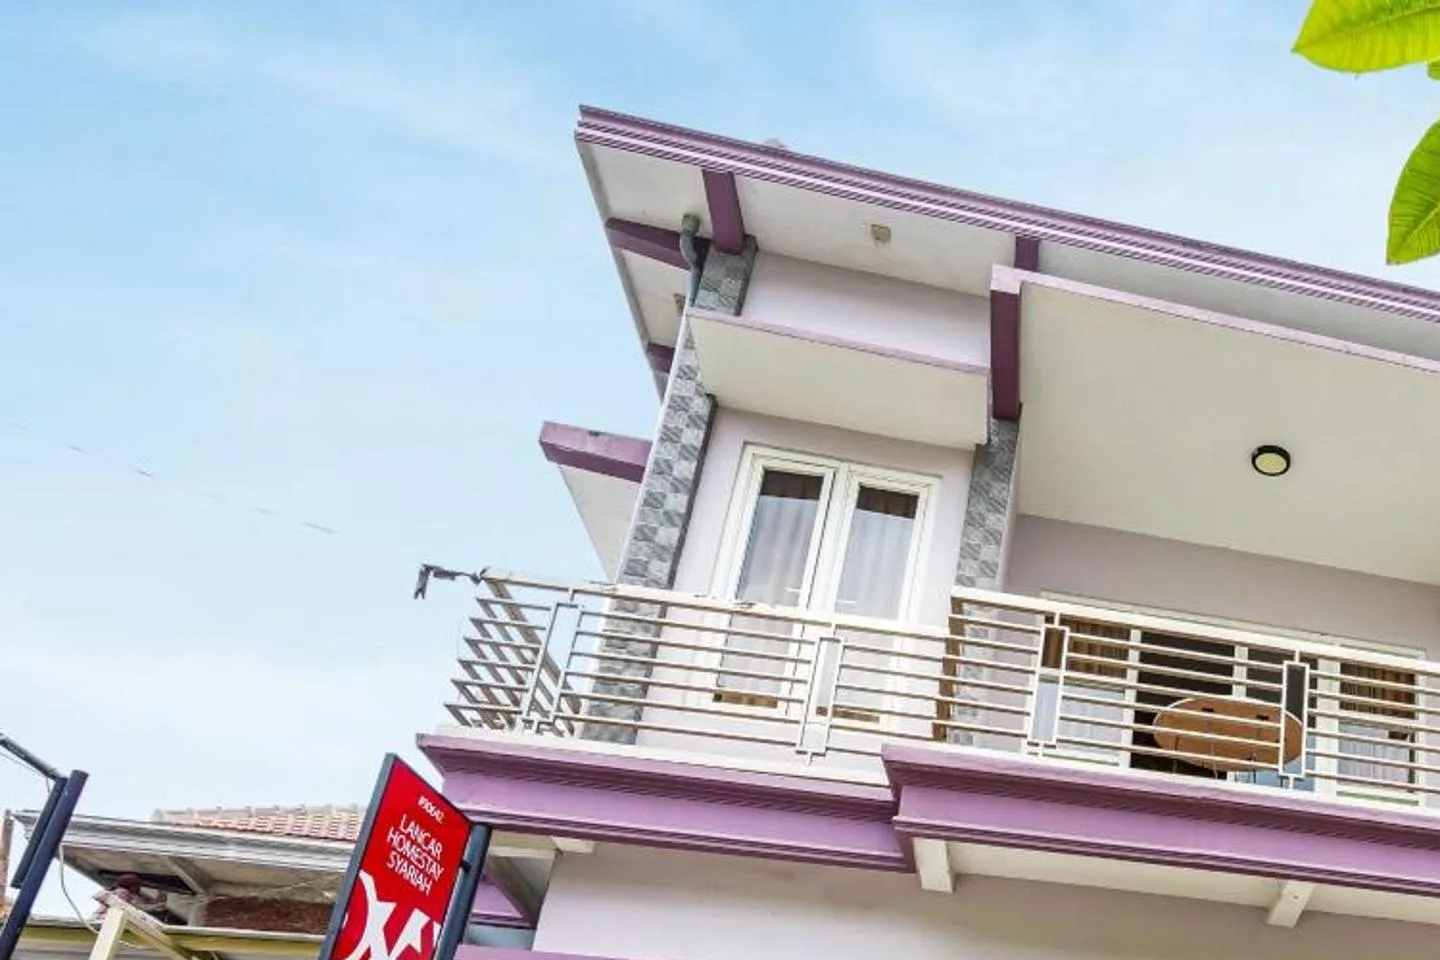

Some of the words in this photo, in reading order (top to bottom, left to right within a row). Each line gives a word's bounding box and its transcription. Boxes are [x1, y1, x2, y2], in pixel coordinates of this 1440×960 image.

[387, 826, 444, 882] HOMESTAY
[399, 814, 443, 860] LANCAR
[386, 851, 432, 896] SYARIAH
